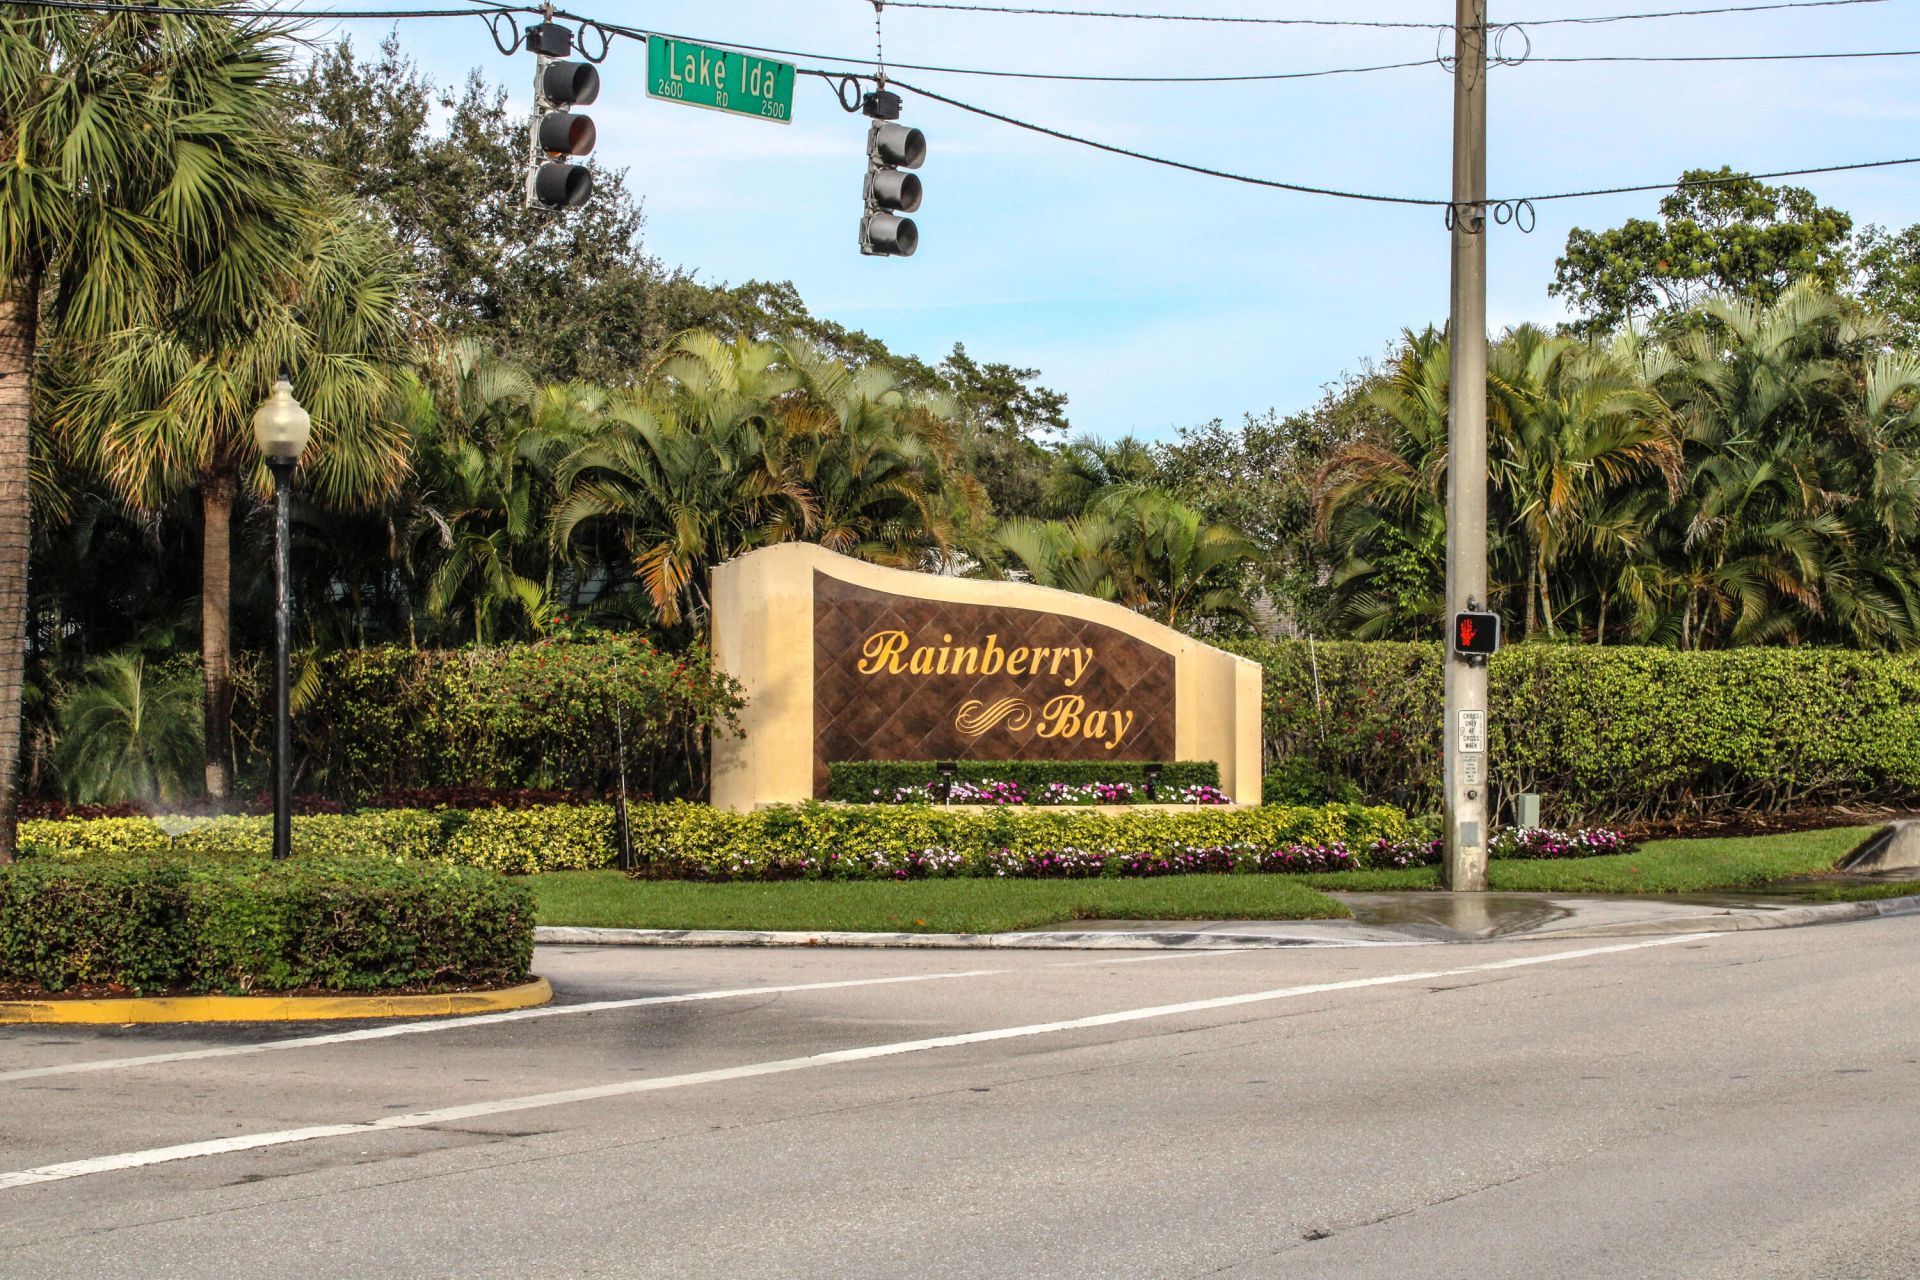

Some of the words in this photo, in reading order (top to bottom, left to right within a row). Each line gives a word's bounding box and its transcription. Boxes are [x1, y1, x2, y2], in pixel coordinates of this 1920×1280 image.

[658, 79, 683, 98] 2600
[670, 42, 726, 89] Lake
[741, 57, 775, 99] Ida
[716, 91, 729, 107] RD
[761, 100, 785, 118] 2500
[857, 630, 1094, 687] Rainberry
[1036, 694, 1134, 750] Bay
